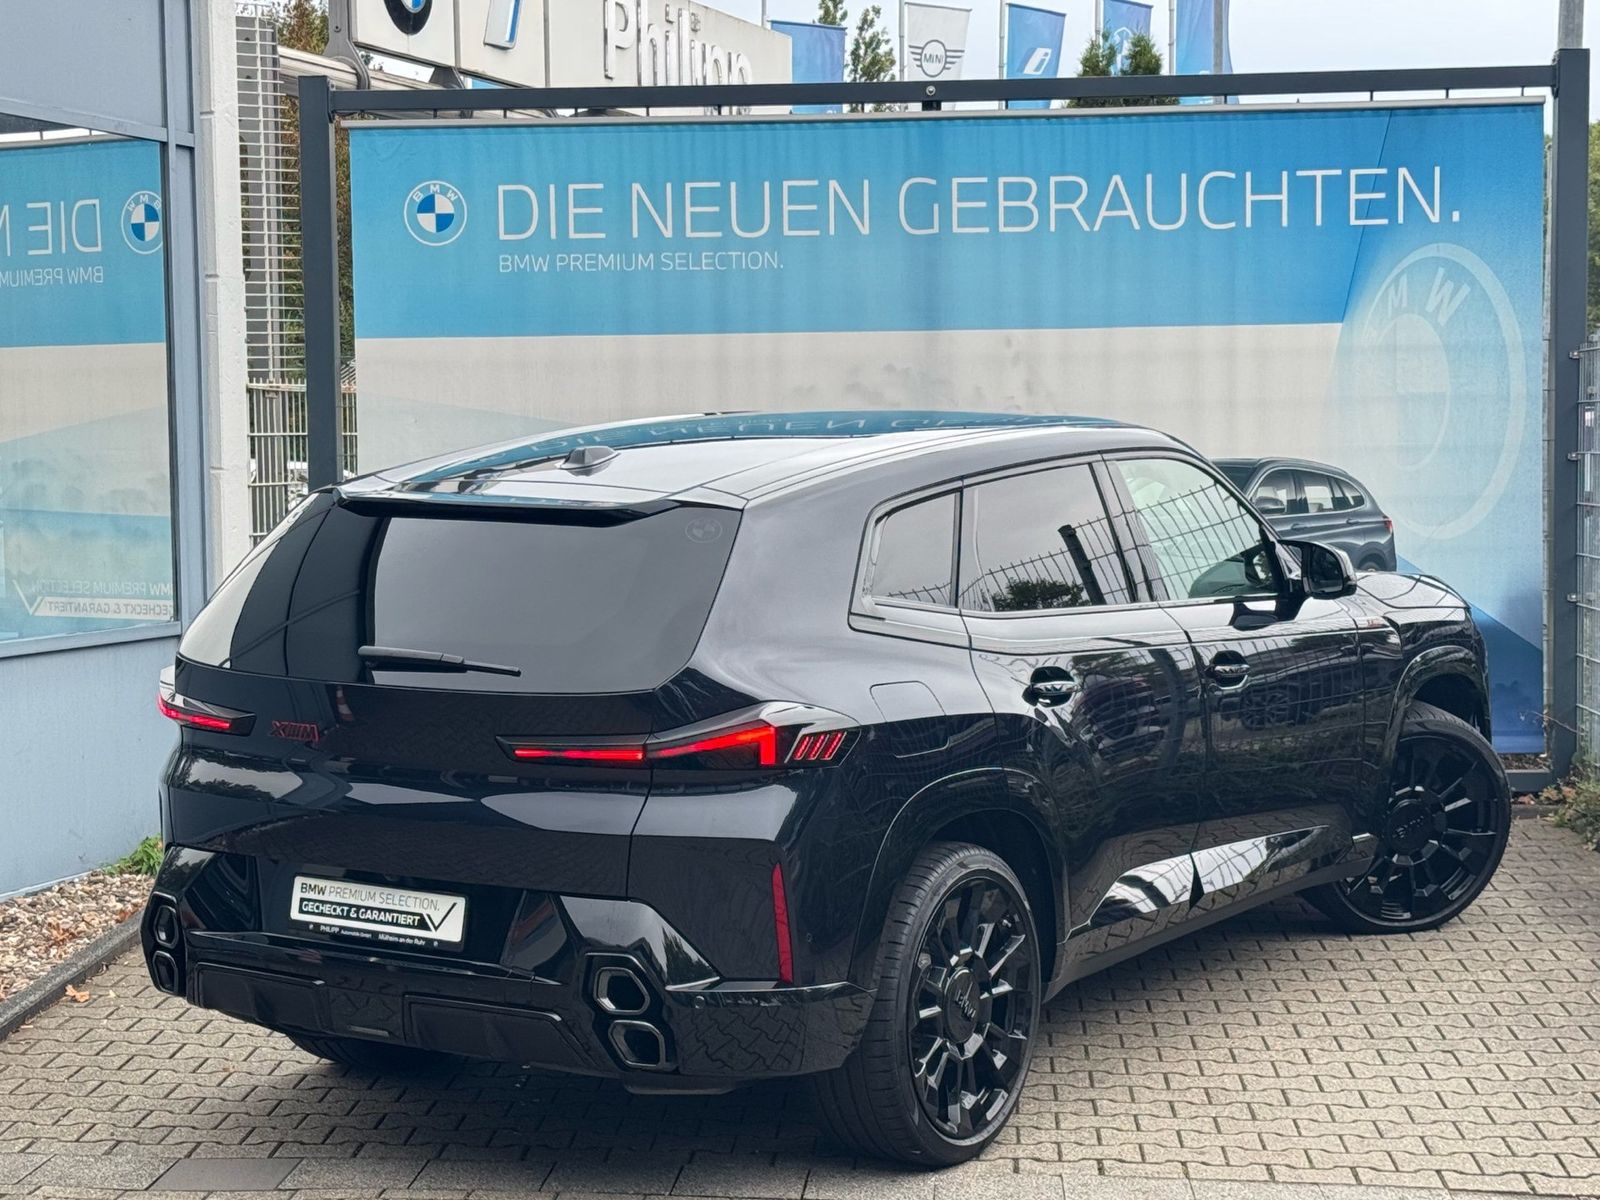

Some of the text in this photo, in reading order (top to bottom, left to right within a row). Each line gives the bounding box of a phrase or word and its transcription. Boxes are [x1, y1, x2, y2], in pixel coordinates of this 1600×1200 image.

[923, 53, 944, 64] MINI
[412, 184, 458, 202] BMW
[498, 165, 1461, 240] DIE NEUEN GEBRAUCHTEN.
[499, 251, 784, 273] BMW PREMIUM SELECTION.
[300, 882, 440, 912] BMW PREMIUM SELECTION.
[302, 900, 421, 926] GECHECKT & GARANTIERT
